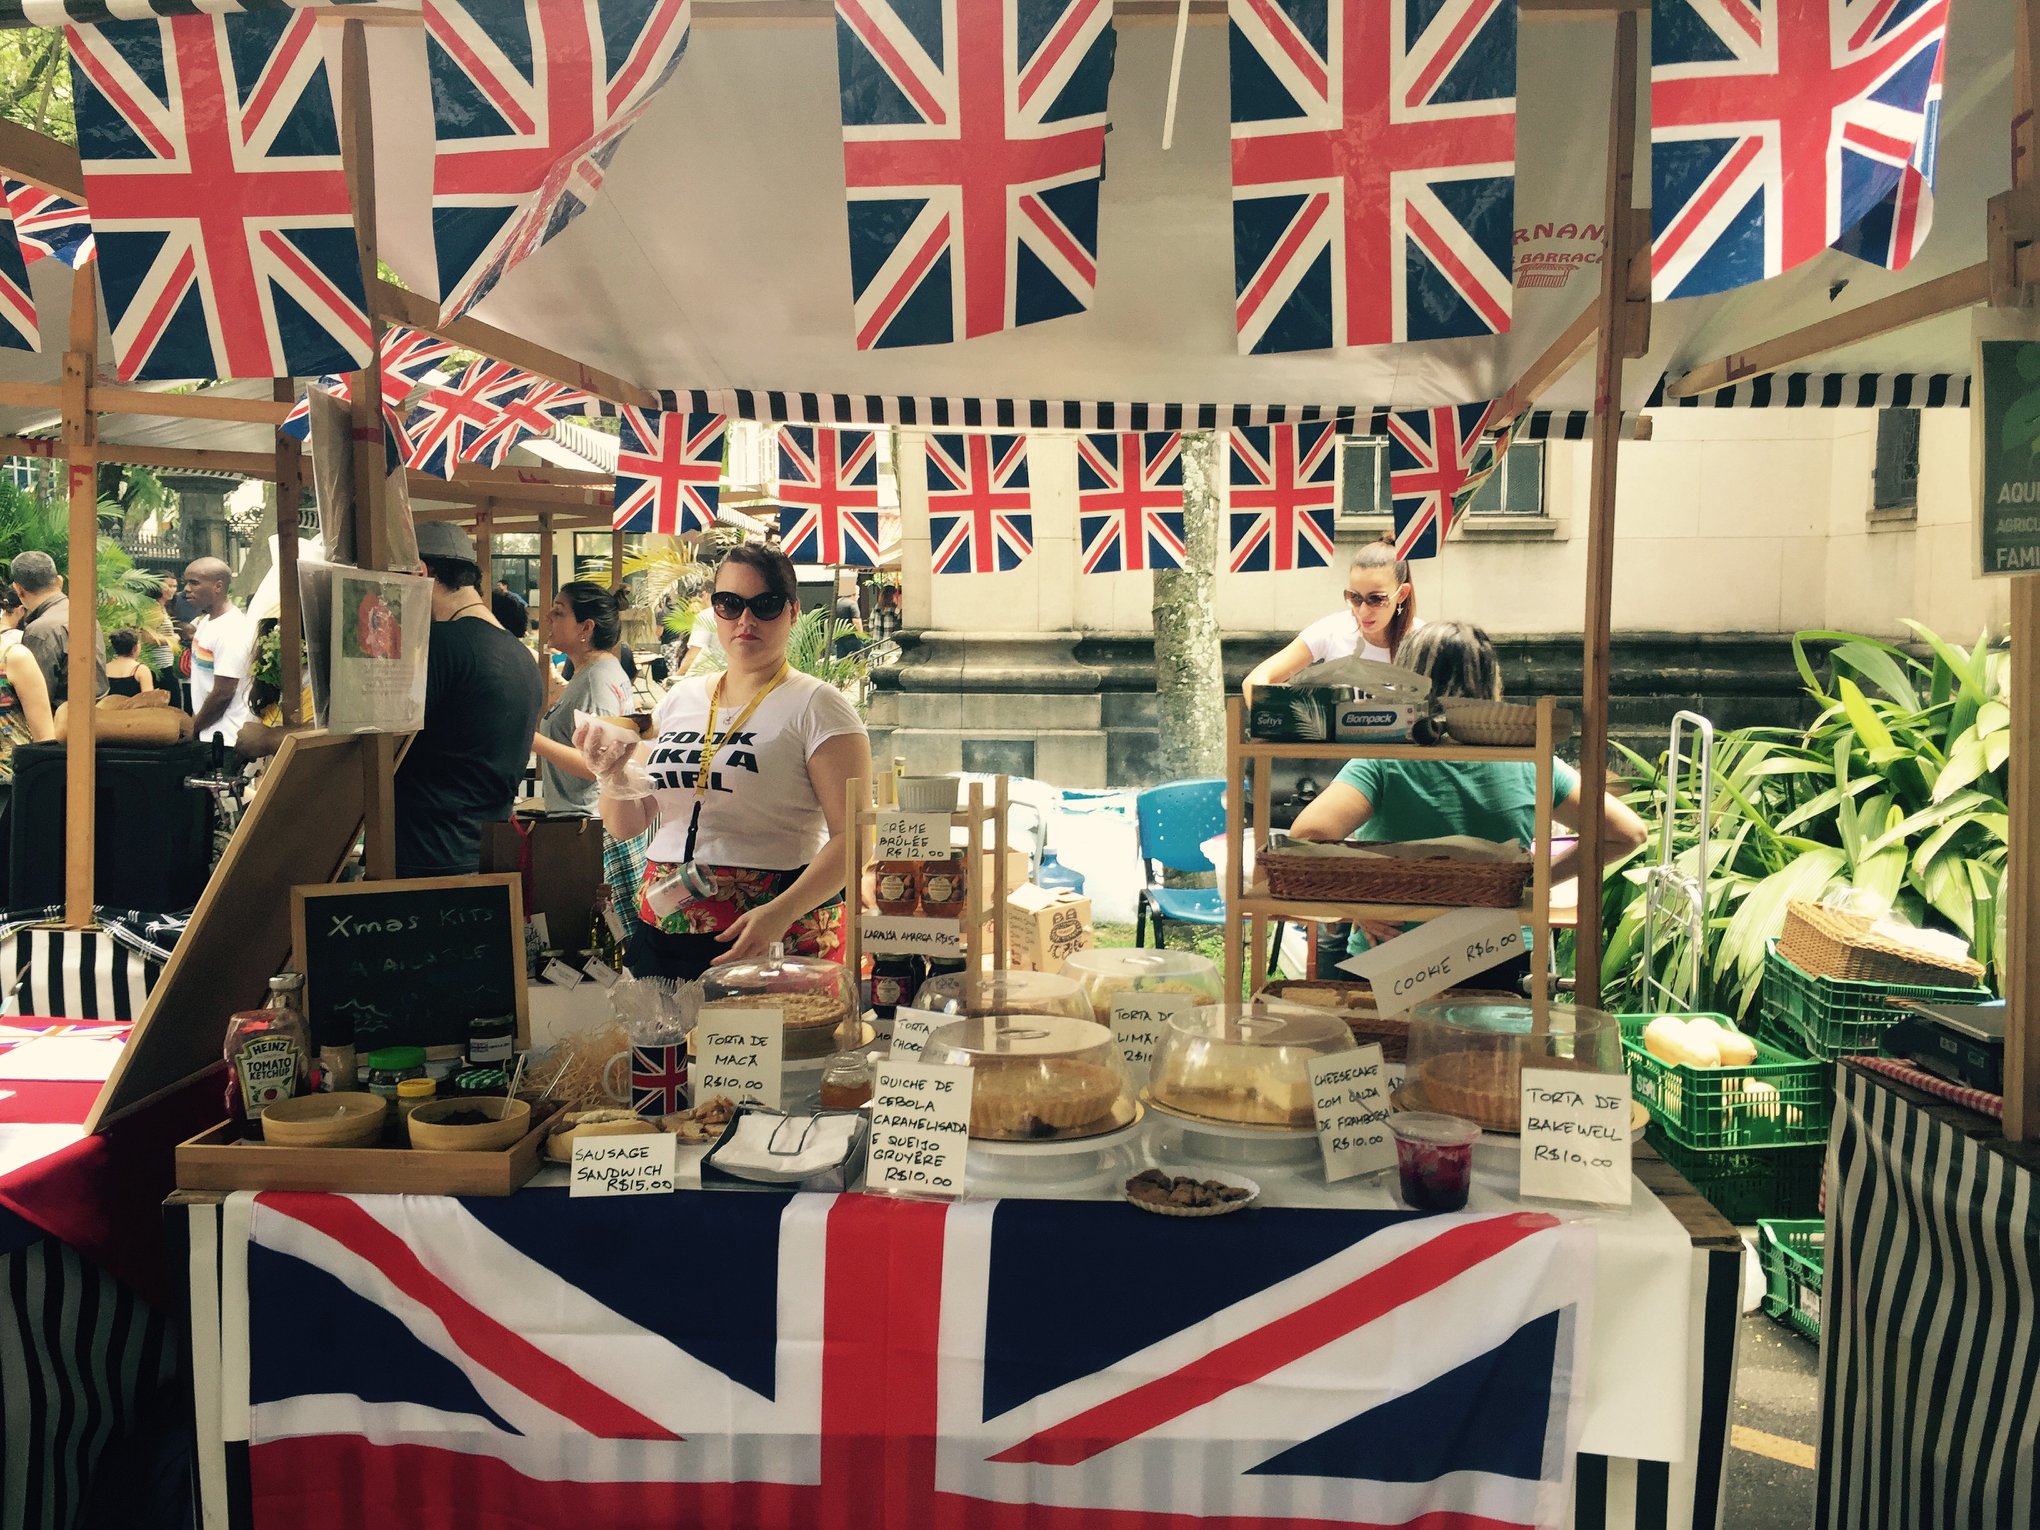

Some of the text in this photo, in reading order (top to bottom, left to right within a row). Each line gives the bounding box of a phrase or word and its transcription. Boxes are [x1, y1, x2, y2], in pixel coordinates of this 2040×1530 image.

[1346, 713, 1392, 726] Bompack
[658, 731, 758, 746] COOK
[726, 750, 759, 773] A
[327, 915, 420, 938] Xmas
[900, 931, 934, 943] AMARGA
[1394, 957, 1451, 995] COOKIE
[1115, 1008, 1152, 1022] TORTA
[898, 1018, 930, 1034] TORTA
[706, 1033, 769, 1047] TORTA DE
[252, 1042, 287, 1055] HEINZ
[247, 1057, 292, 1073] TOMATO
[249, 1067, 290, 1080] KETCHUP
[1314, 1065, 1379, 1086] CHEESECAKE
[880, 1075, 954, 1093] QUICHE DE
[878, 1096, 935, 1112] CEBOLA
[1318, 1095, 1341, 1110] COM
[1526, 1088, 1622, 1110] TORTA DE
[873, 1114, 967, 1134] CARAMELISADA
[1319, 1108, 1391, 1132] DE FRAMBOESA
[871, 1132, 940, 1151] E QUEIJO
[575, 1146, 650, 1161] SAUSAGE
[577, 1164, 662, 1182] SANDWICH
